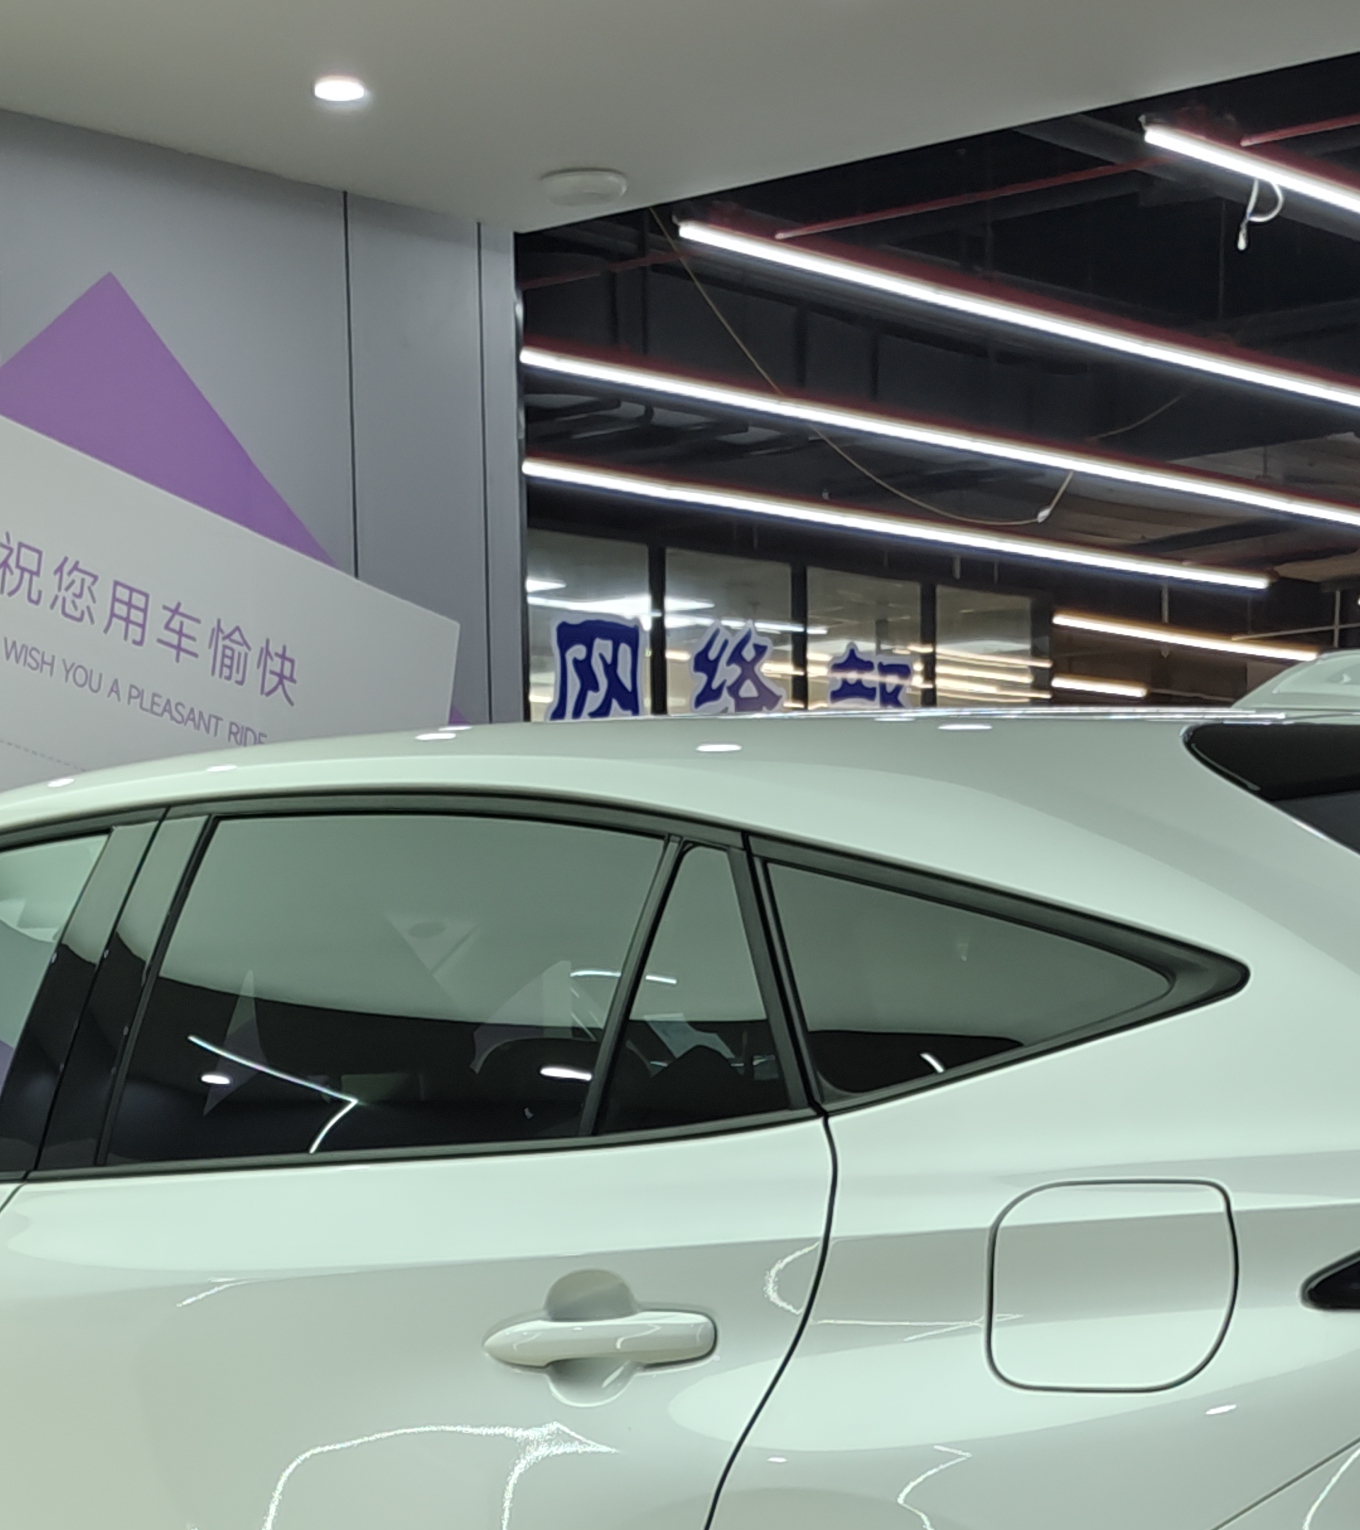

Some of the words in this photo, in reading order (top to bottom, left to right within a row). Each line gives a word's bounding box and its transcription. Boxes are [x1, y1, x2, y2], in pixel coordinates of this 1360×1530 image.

[3, 636, 56, 678] WISH
[61, 658, 103, 694] YOU
[106, 677, 122, 702] A
[127, 683, 224, 738] PLEASANT
